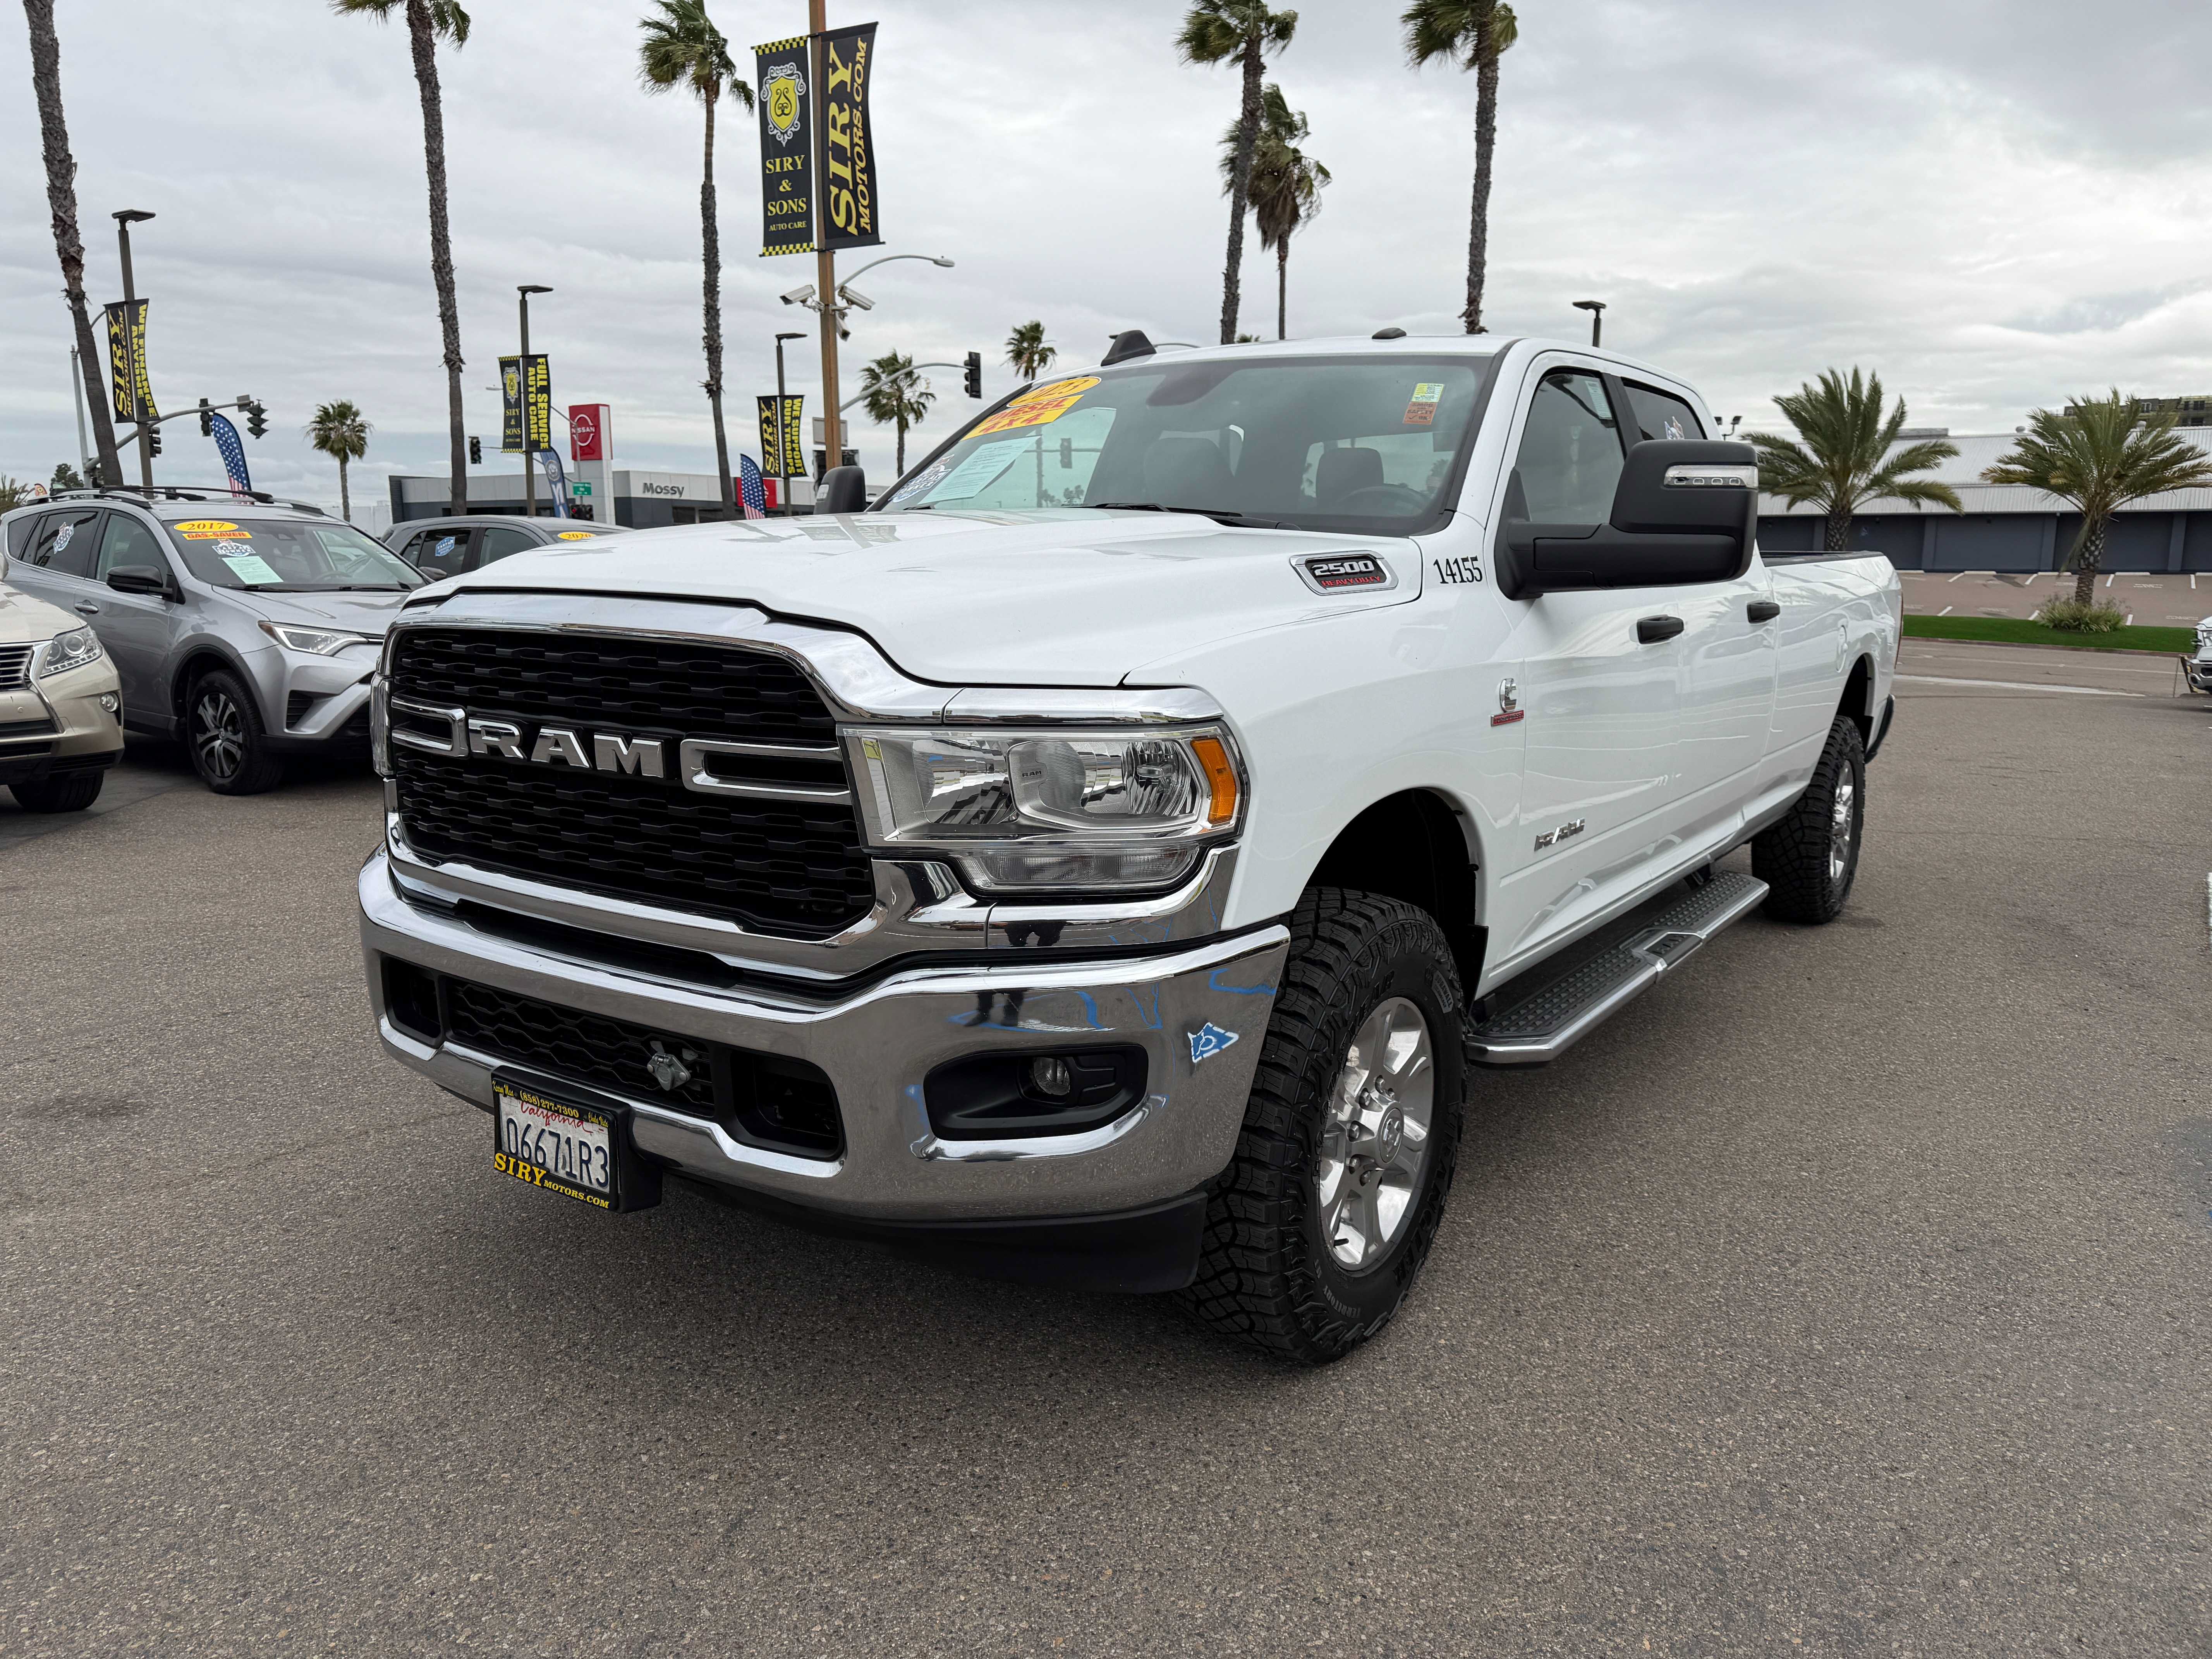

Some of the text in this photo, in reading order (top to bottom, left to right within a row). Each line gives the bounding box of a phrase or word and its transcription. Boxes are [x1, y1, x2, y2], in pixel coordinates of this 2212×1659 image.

[766, 155, 805, 174] SIRY
[828, 41, 859, 237] SIRY
[852, 38, 871, 234] MOTORS.COM
[768, 198, 807, 216] SONS
[779, 179, 792, 192] &
[769, 221, 807, 232] AUTO CARE
[108, 309, 128, 417] SIRY
[131, 325, 144, 398] ANYONE
[138, 304, 157, 417] WE FINANCE
[505, 408, 520, 416] SIRY
[528, 367, 538, 441] AUTO CARE
[537, 358, 549, 450] FULL SERVICE
[987, 398, 1070, 423] DIESEL
[760, 399, 775, 474] SIRY
[784, 399, 795, 474] OUR TROOPS
[792, 398, 805, 474] WE SUPPORT
[642, 483, 684, 498] Mossy
[1311, 560, 1375, 576] 2500
[1321, 577, 1354, 587] HEAVY
[1433, 555, 1483, 584] 14155
[468, 718, 665, 778] RAM
[521, 1101, 594, 1133] California
[494, 1152, 610, 1209] SIRY MOTORS.COM
[506, 1117, 609, 1188] 06671R3
[1392, 1102, 1460, 1288] WRANGLER
[1323, 1285, 1361, 1319] TERRITORY
